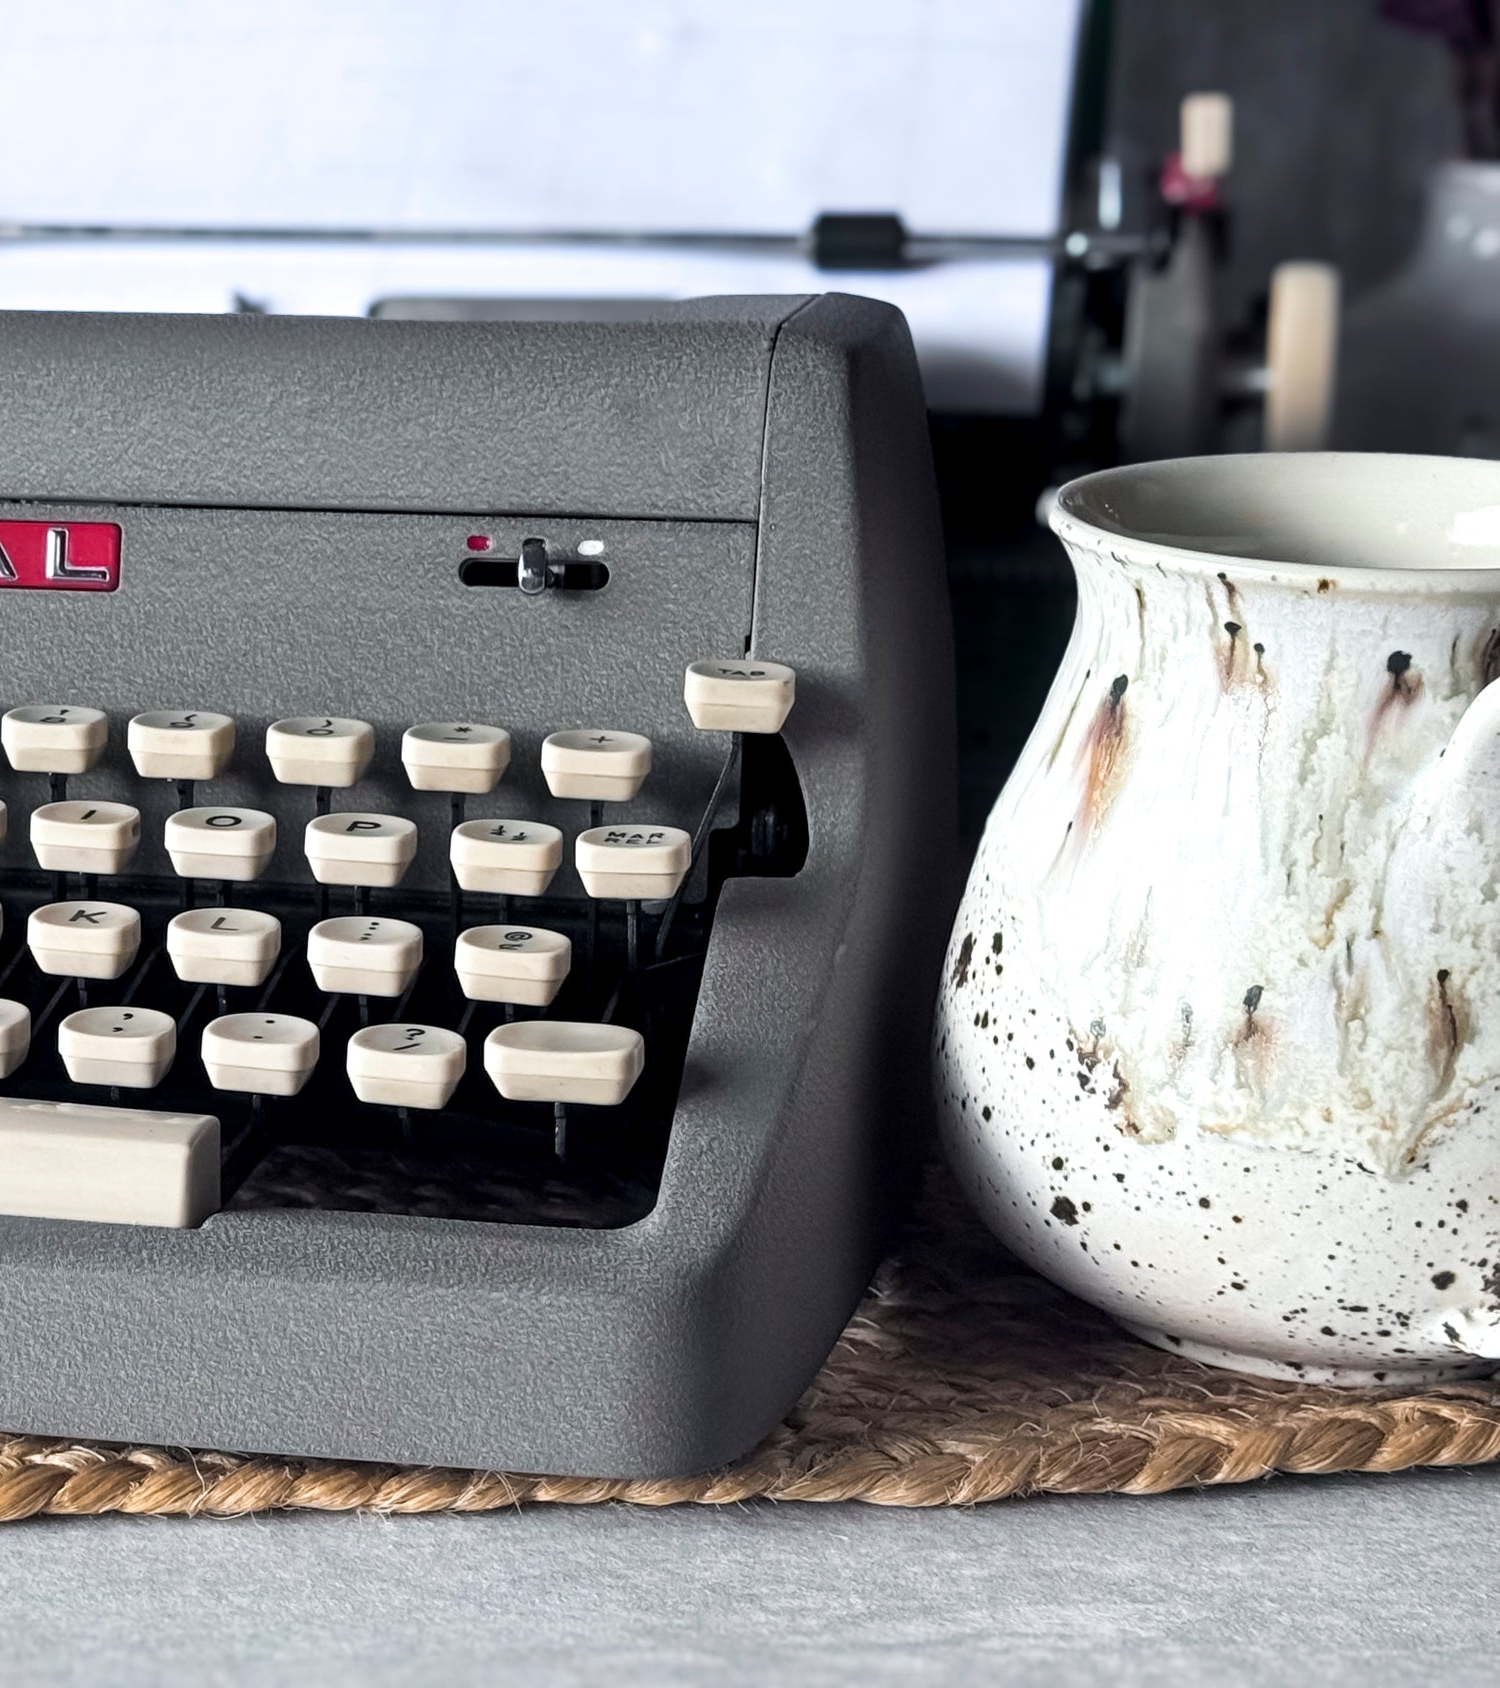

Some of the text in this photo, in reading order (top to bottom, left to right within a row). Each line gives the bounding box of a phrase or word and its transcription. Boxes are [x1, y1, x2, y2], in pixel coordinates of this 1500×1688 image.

[717, 667, 766, 677] TAB
[205, 816, 242, 827] O
[345, 820, 382, 832] P
[607, 831, 665, 840] MAR
[68, 910, 107, 923] K
[210, 917, 238, 931] L
